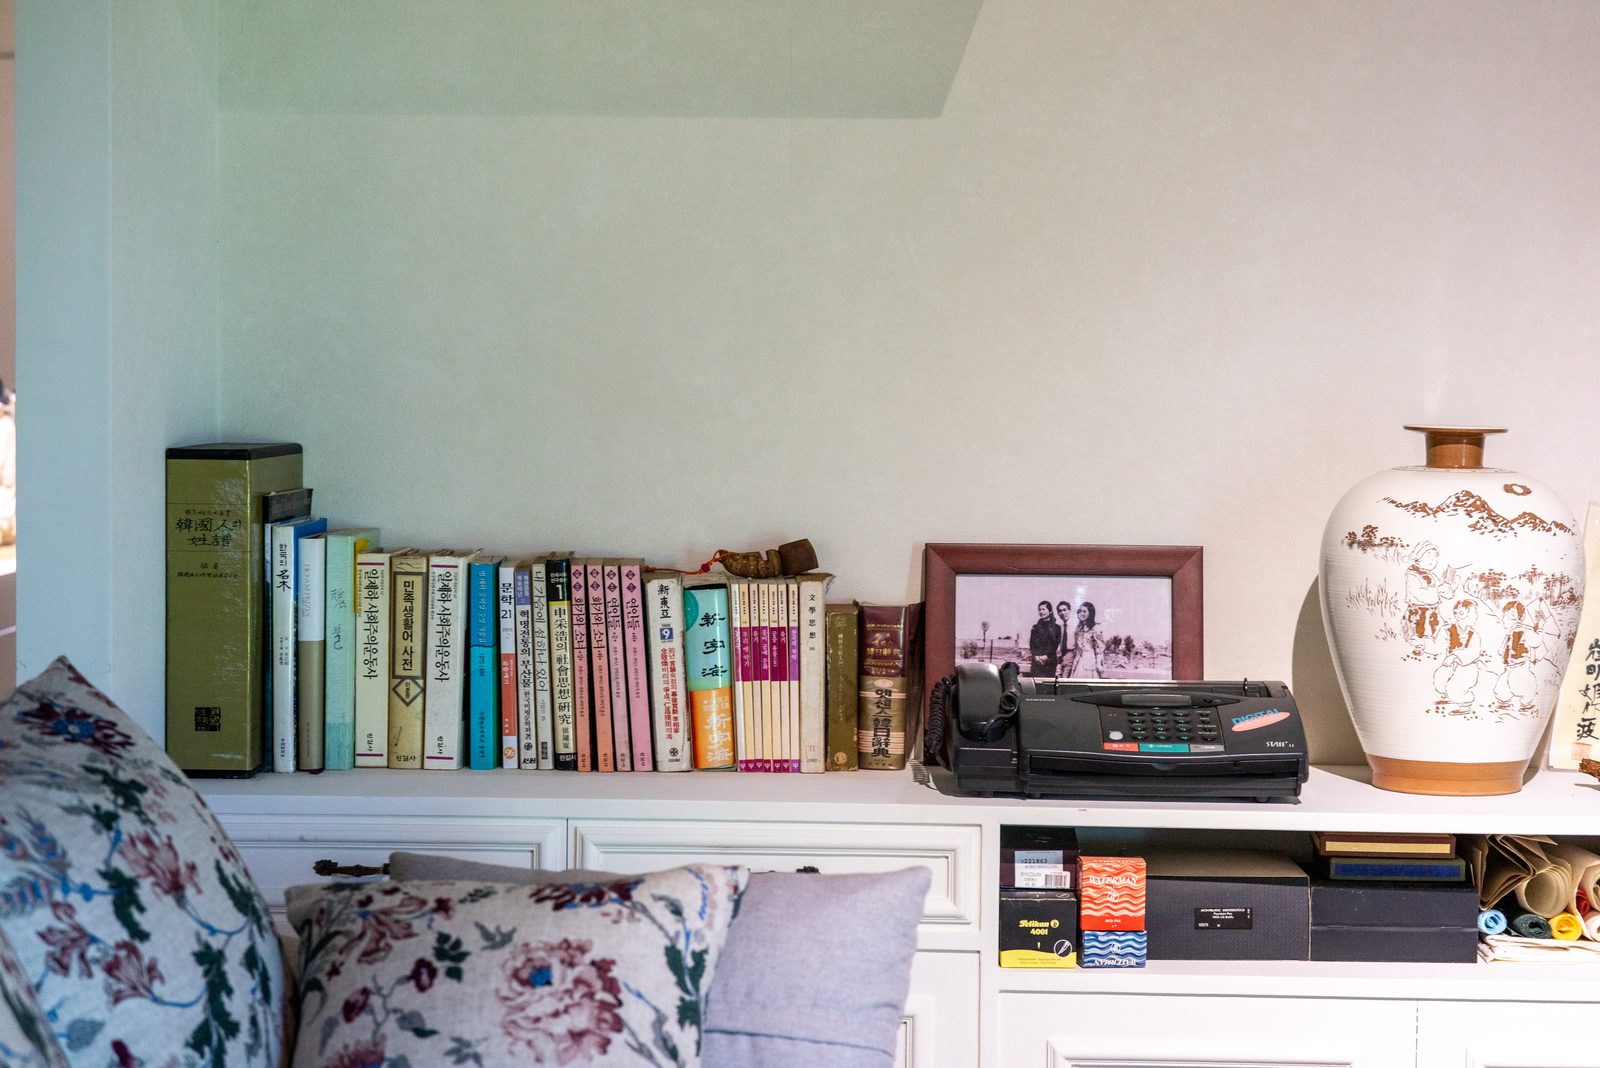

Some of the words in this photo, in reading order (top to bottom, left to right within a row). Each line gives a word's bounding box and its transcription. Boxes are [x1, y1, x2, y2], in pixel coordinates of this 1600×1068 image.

[276, 569, 291, 590] 名木
[363, 568, 379, 601] 일제하
[436, 571, 453, 604] 일제하
[501, 582, 514, 605] 문학
[556, 584, 563, 600] 1
[402, 580, 415, 643] 민족생활어
[501, 609, 512, 619] 21
[572, 596, 585, 626] 화가와
[591, 595, 604, 626] 화가와
[606, 597, 620, 630] 연인들
[626, 597, 640, 630] 연인들
[658, 583, 672, 619] 新東亞
[808, 593, 816, 640] 文學思想
[362, 603, 379, 680] 사회주의운동사
[434, 606, 451, 682] 사회주의운동사
[574, 629, 586, 649] 소녀
[593, 629, 605, 649] 소녀
[662, 629, 670, 639] 9
[402, 646, 414, 671] 사전
[1019, 919, 1049, 928] Pelikan
